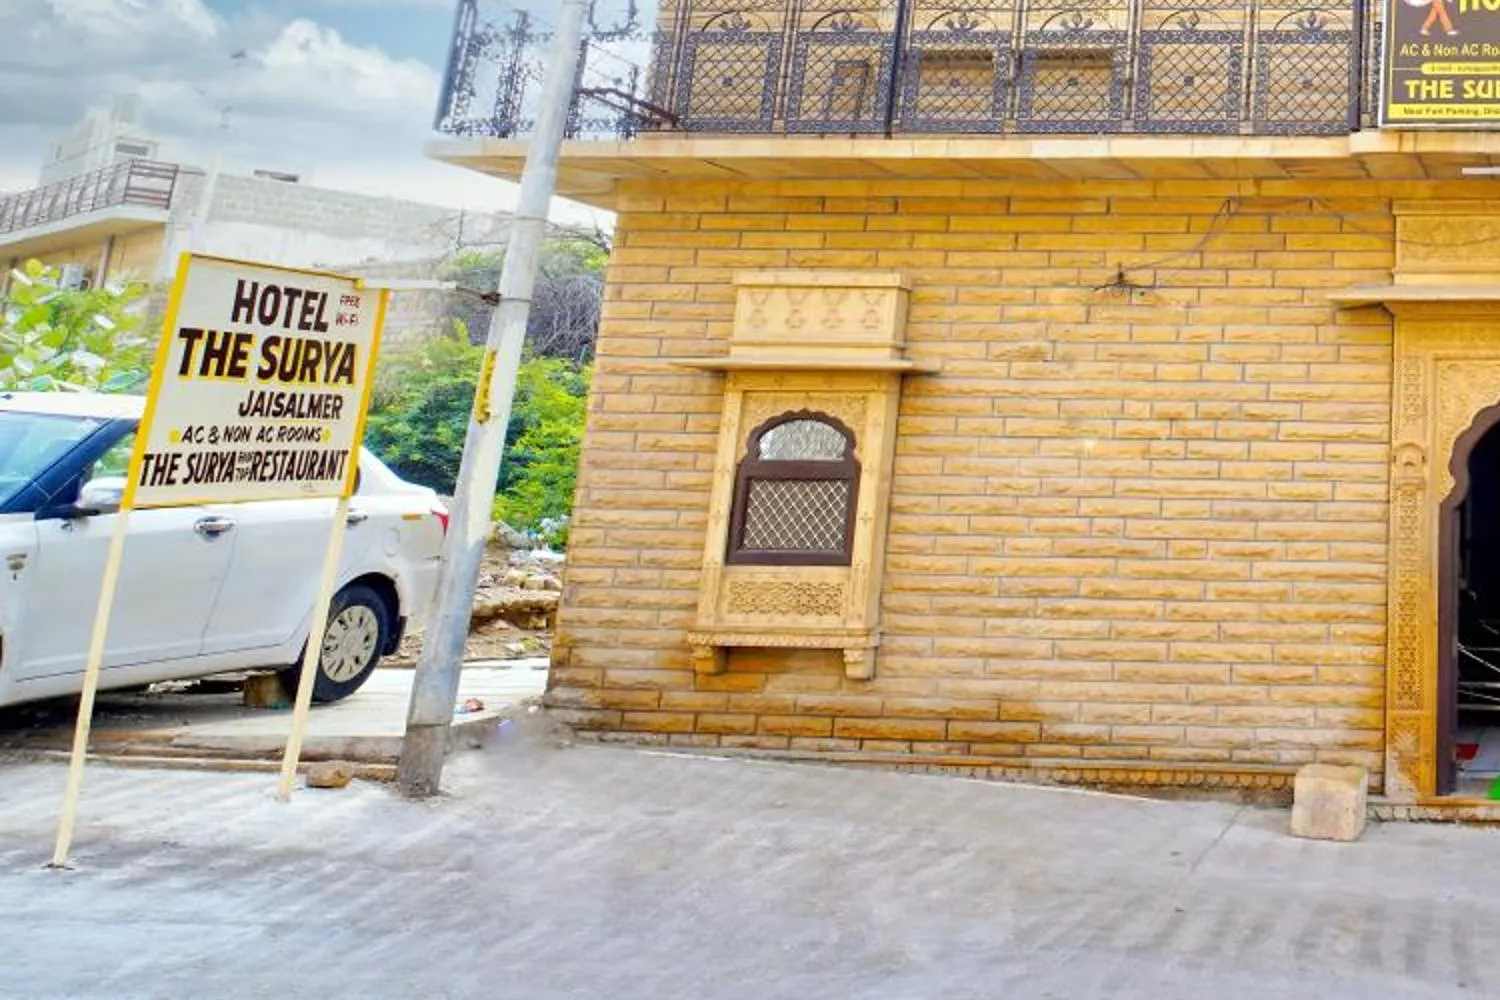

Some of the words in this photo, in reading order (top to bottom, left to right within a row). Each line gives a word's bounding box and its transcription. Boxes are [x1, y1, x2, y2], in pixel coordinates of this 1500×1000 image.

[1400, 43, 1419, 56] AC
[1421, 43, 1431, 56] &
[1433, 43, 1458, 56] Non
[1461, 43, 1479, 56] AC
[1404, 79, 1454, 100] THE
[231, 279, 329, 332] HOTEL
[178, 327, 252, 379] THE
[257, 335, 358, 384] SURYA
[238, 390, 344, 420] JAISALMER
[181, 425, 204, 443] AC
[207, 425, 220, 445] &
[223, 425, 253, 443] NON
[256, 425, 273, 442] AC
[276, 425, 323, 443] ROOMS
[139, 452, 183, 487] THE
[182, 450, 237, 485] SURYA
[247, 449, 350, 483] RESTAURANT
